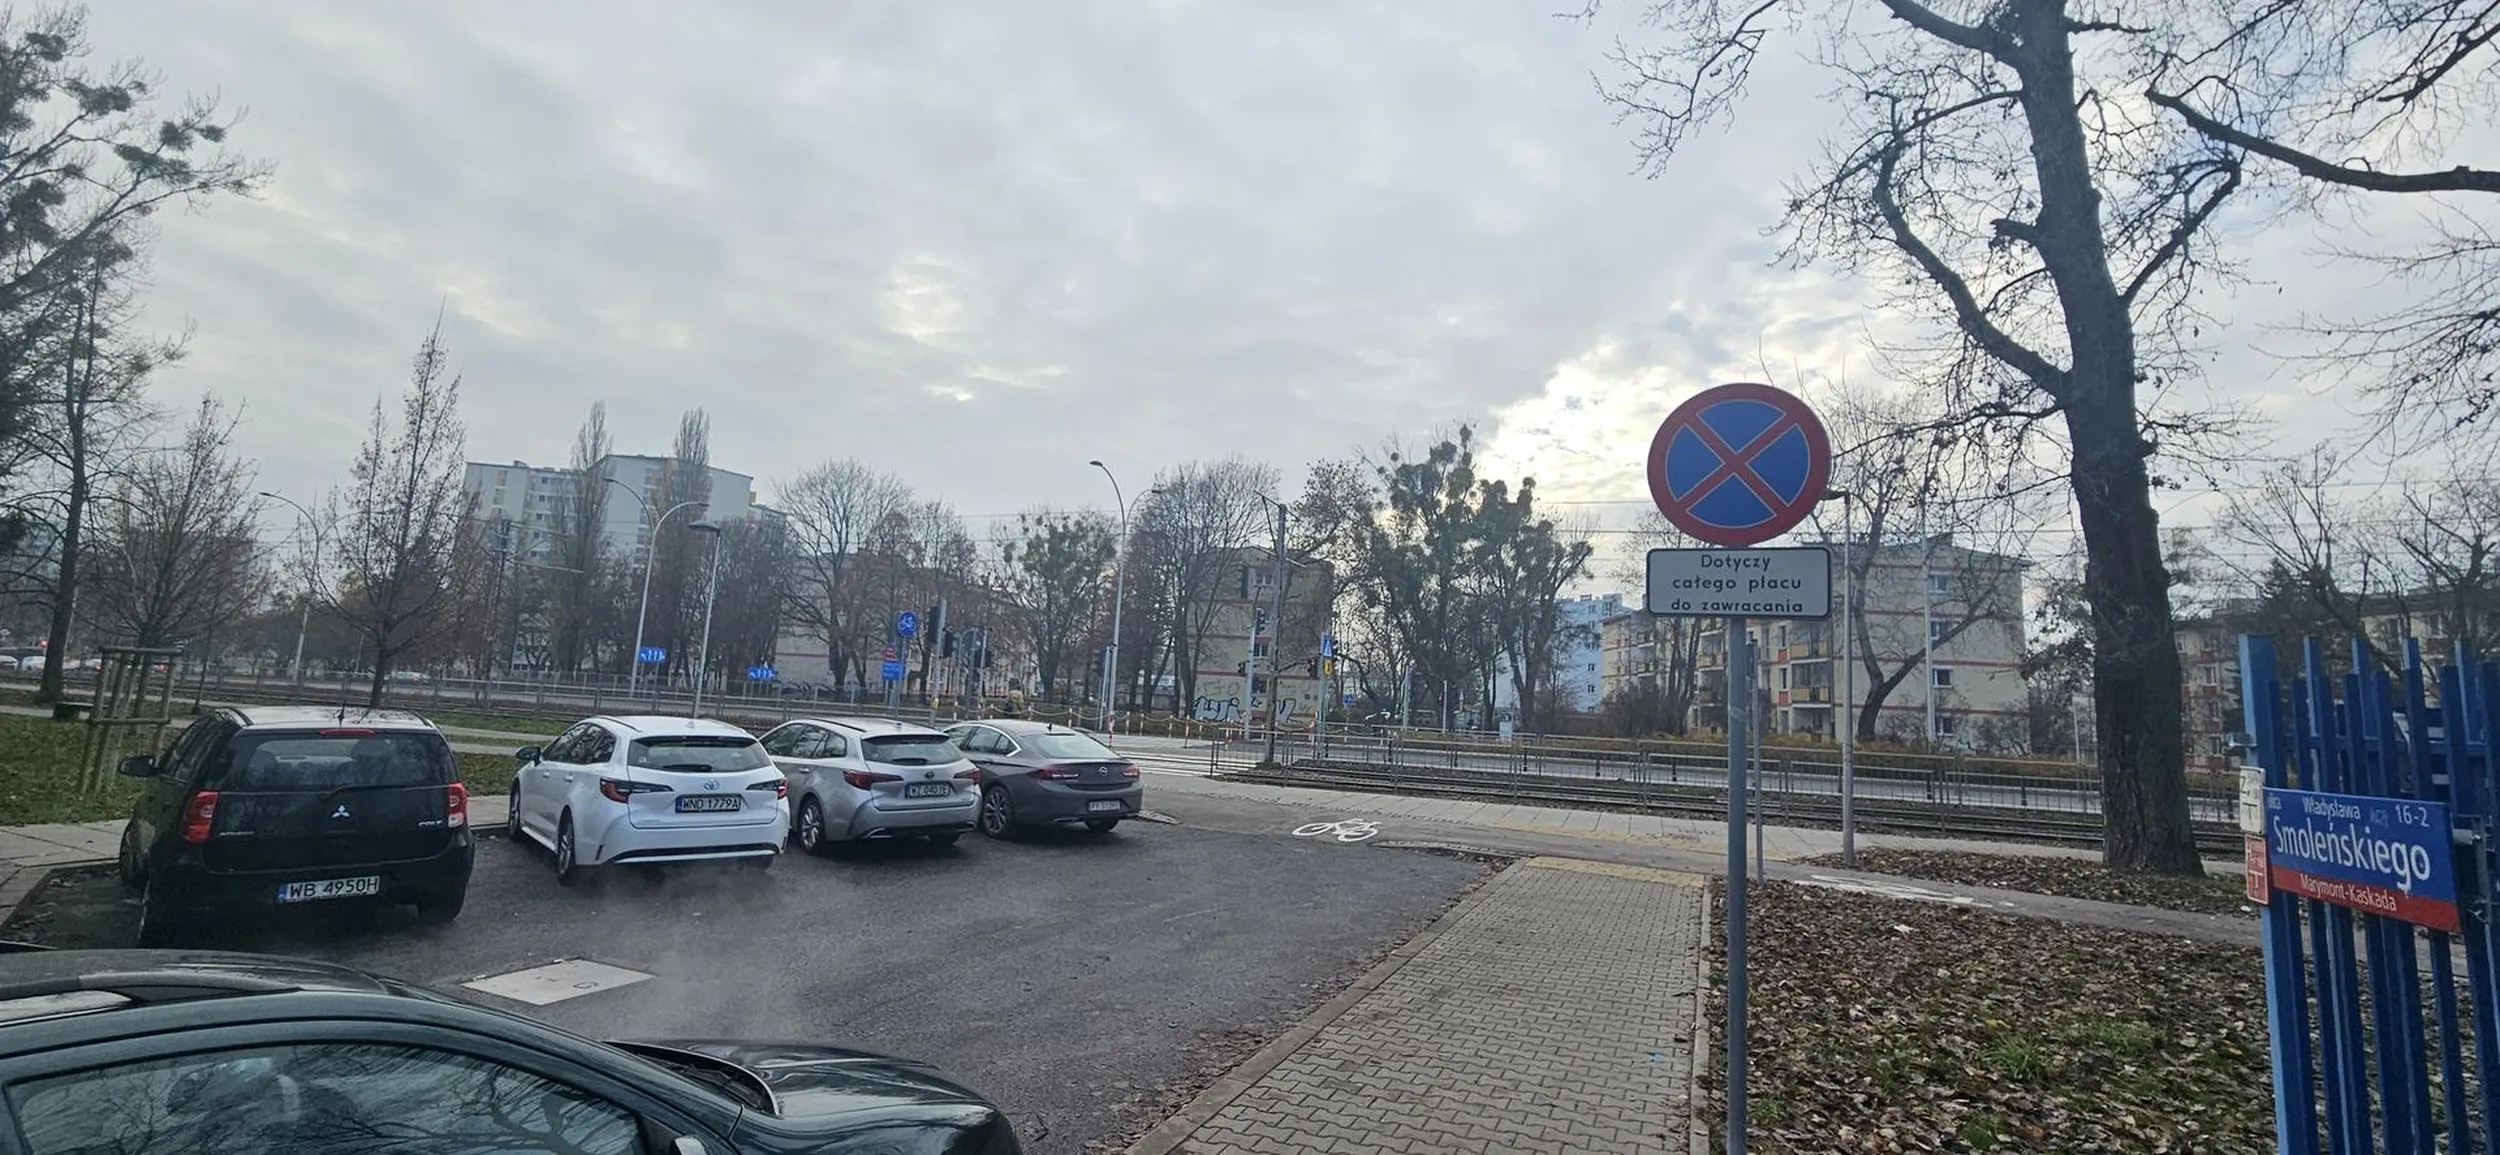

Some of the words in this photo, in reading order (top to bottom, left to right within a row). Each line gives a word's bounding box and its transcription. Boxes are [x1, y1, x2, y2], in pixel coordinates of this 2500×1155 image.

[1701, 554, 1771, 572] Dotyczy
[1672, 575, 1737, 592] całego
[1748, 576, 1802, 592] placu
[1670, 599, 1691, 611] do
[1702, 599, 1803, 613] zawracania
[683, 798, 704, 809] WND
[708, 798, 738, 809] 1779A
[2302, 796, 2361, 821] Władysława
[2395, 804, 2430, 827] 16-2
[2273, 815, 2431, 893] Smoleńskiego
[289, 883, 317, 898] WB
[323, 878, 380, 895] 4950H
[2300, 873, 2397, 912] Marymont-Kaskada
